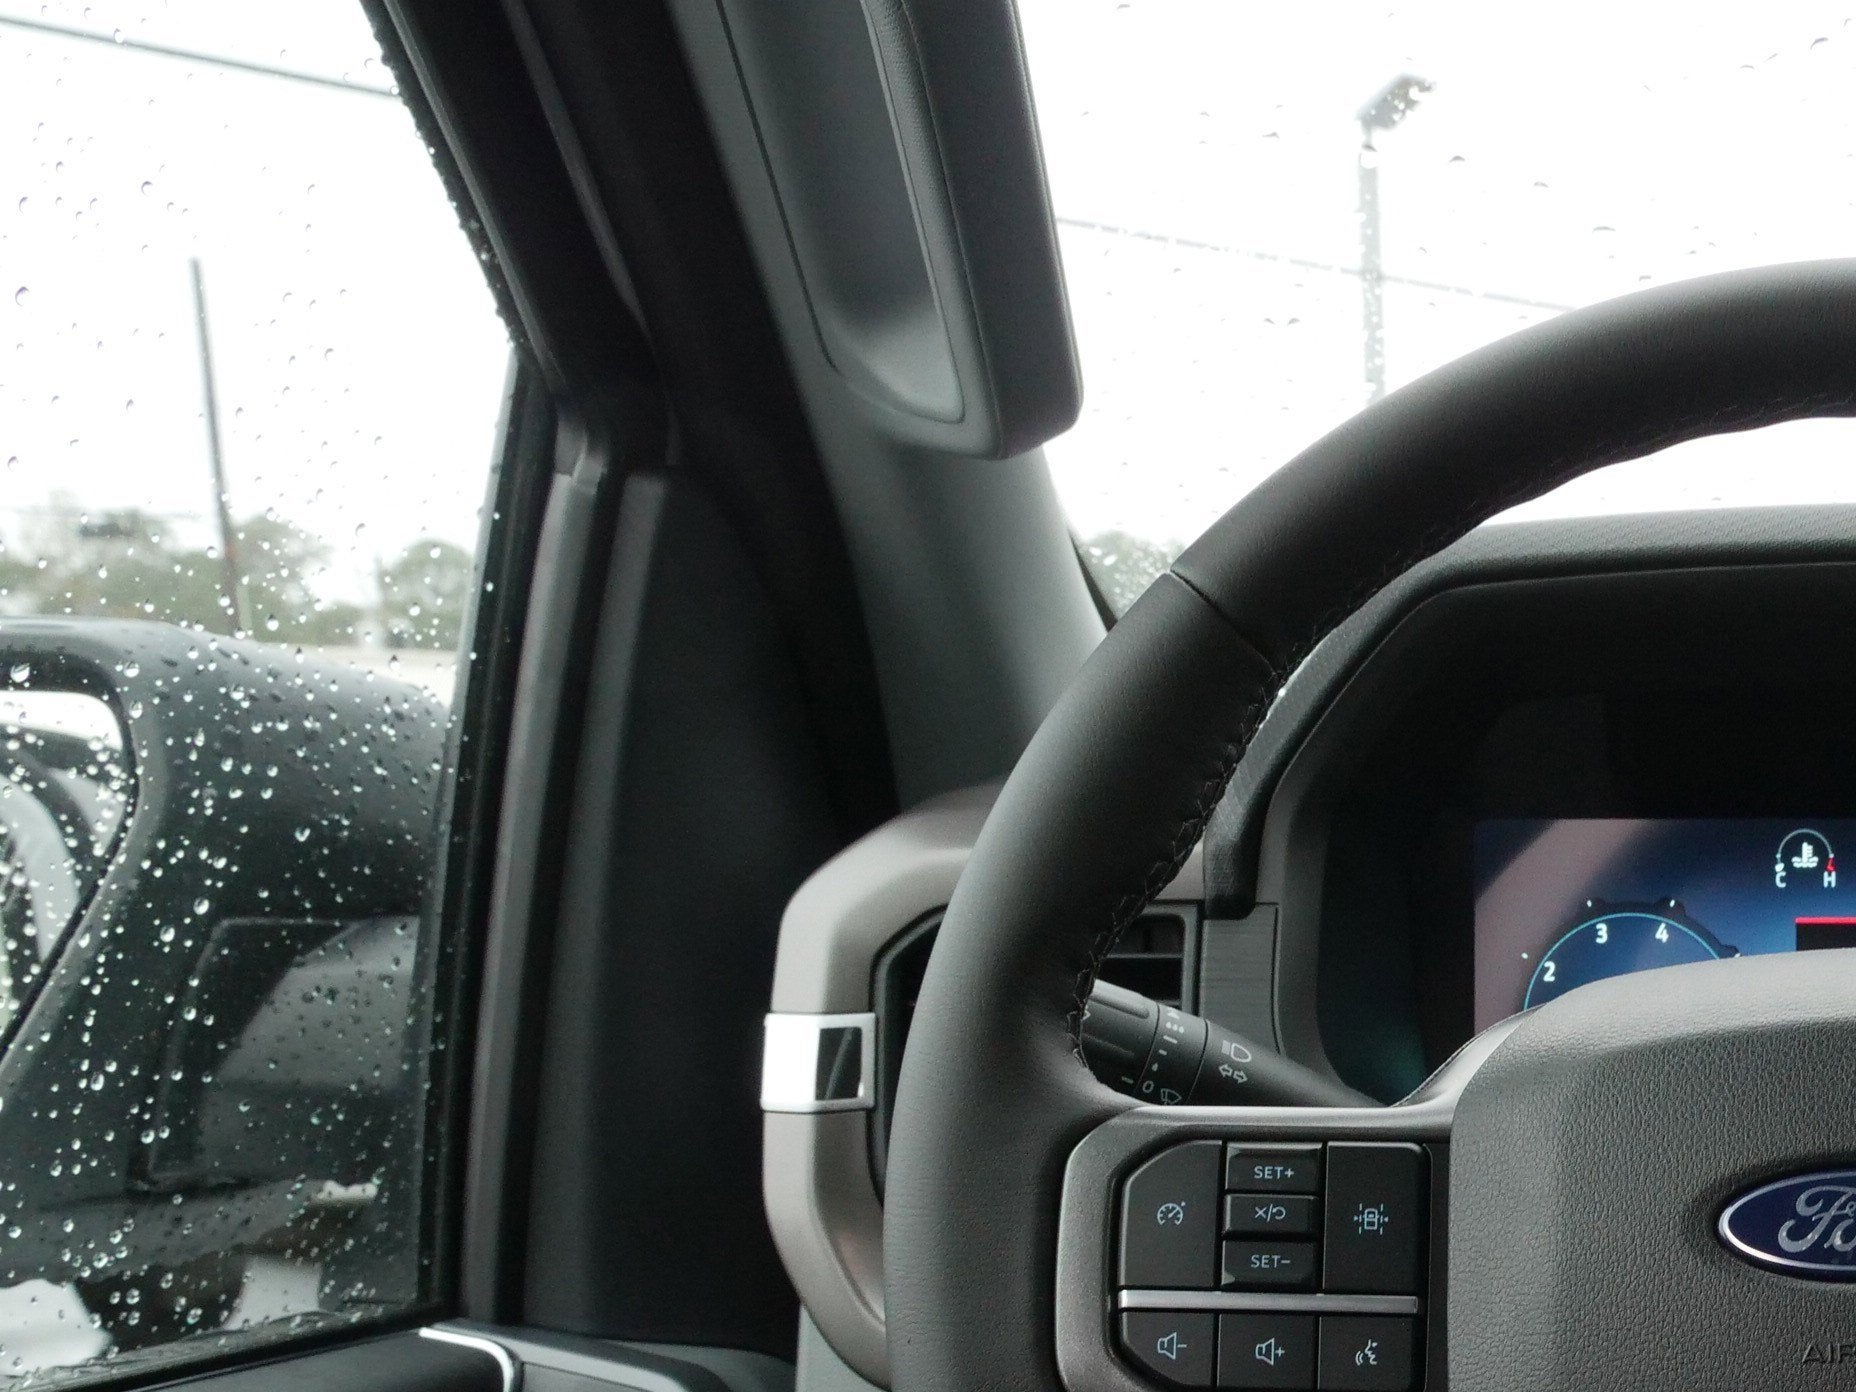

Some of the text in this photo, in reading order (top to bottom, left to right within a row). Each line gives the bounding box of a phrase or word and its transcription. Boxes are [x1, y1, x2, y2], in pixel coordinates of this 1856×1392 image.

[1775, 870, 1787, 888] C
[1823, 870, 1837, 888] H
[1595, 922, 1608, 944] 3
[1655, 922, 1669, 944] 4
[1542, 961, 1556, 982] 2
[1253, 1166, 1295, 1180] SET+
